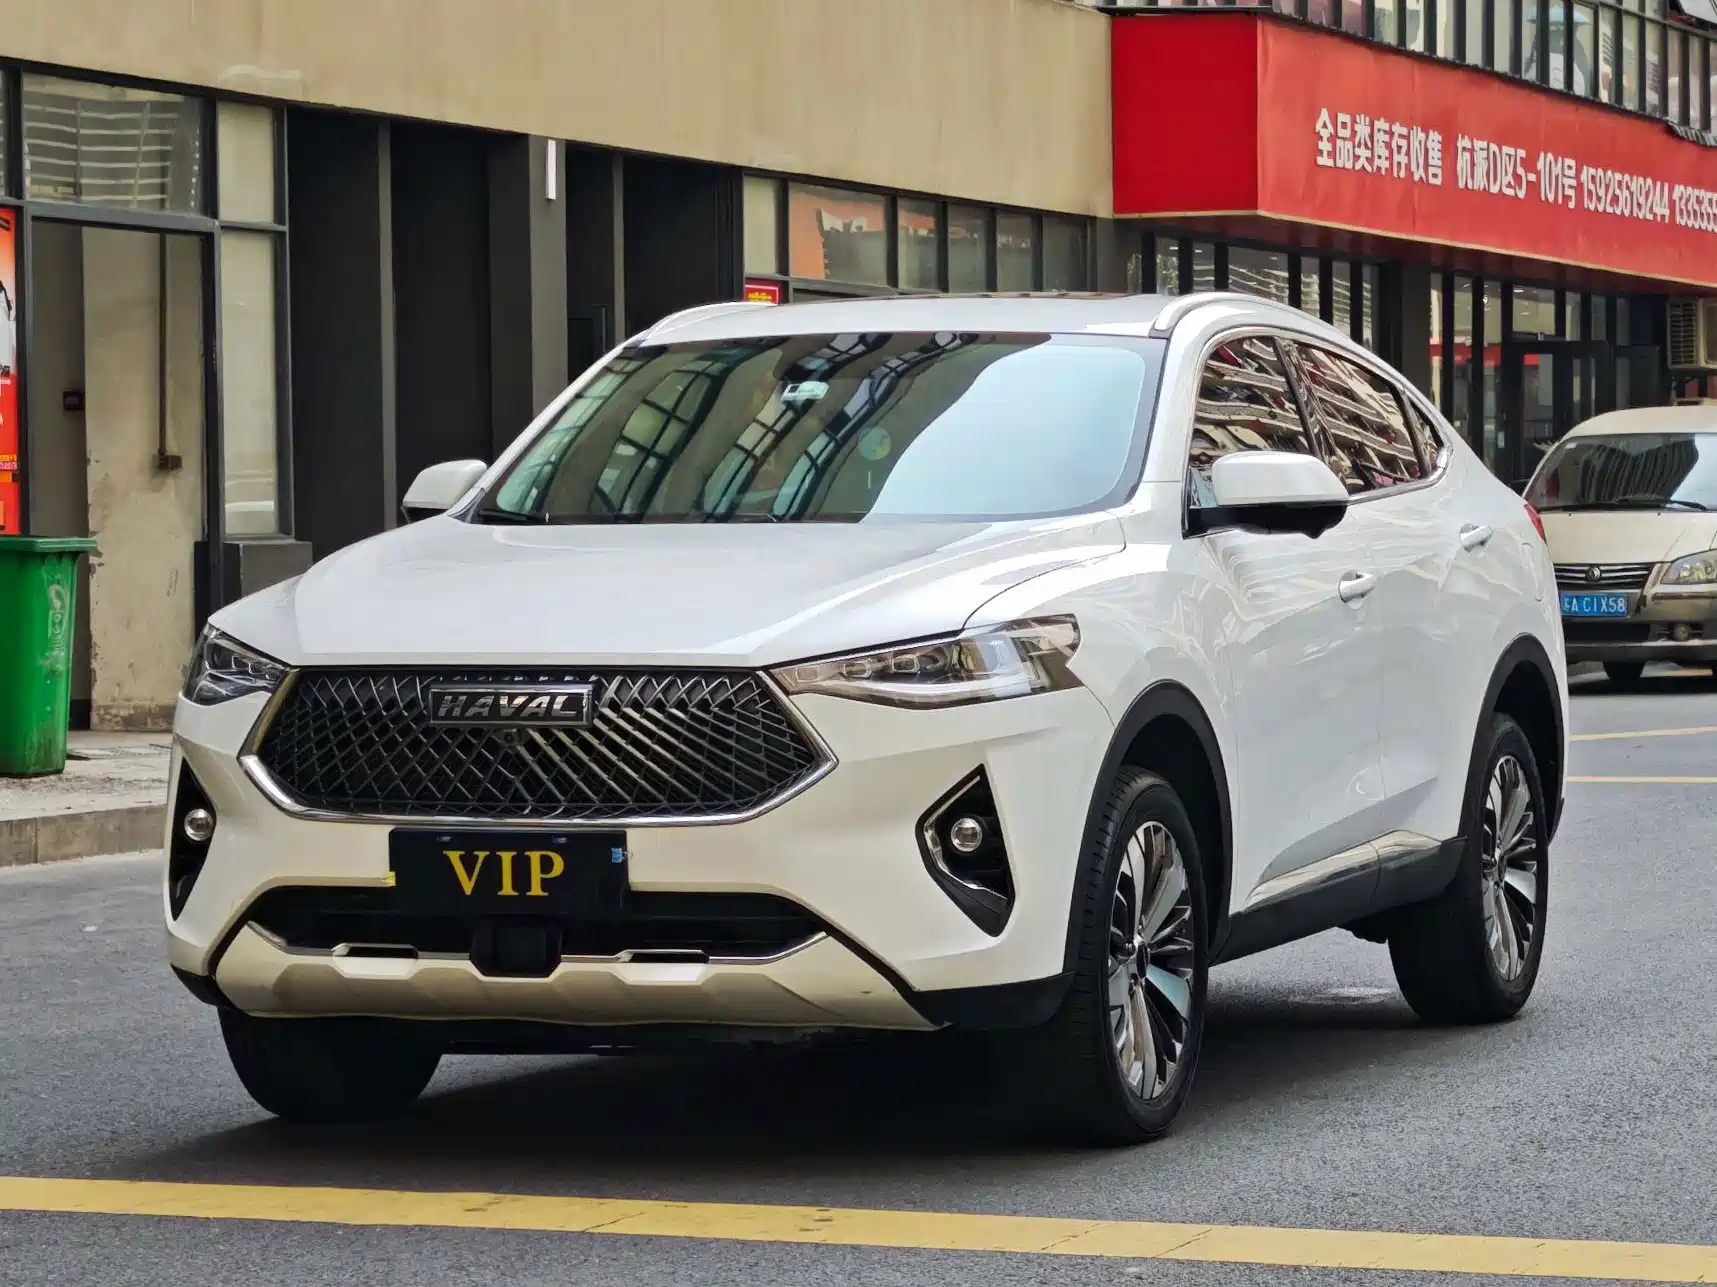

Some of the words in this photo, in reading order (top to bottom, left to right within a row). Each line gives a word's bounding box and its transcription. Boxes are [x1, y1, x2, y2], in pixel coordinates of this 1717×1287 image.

[1315, 107, 1443, 185] 全品类库存收售
[1456, 132, 1577, 209] 杭派D区5-101号
[1580, 164, 1670, 224] 15925619244
[438, 695, 577, 717] HAVAL
[443, 850, 565, 896] VIP
